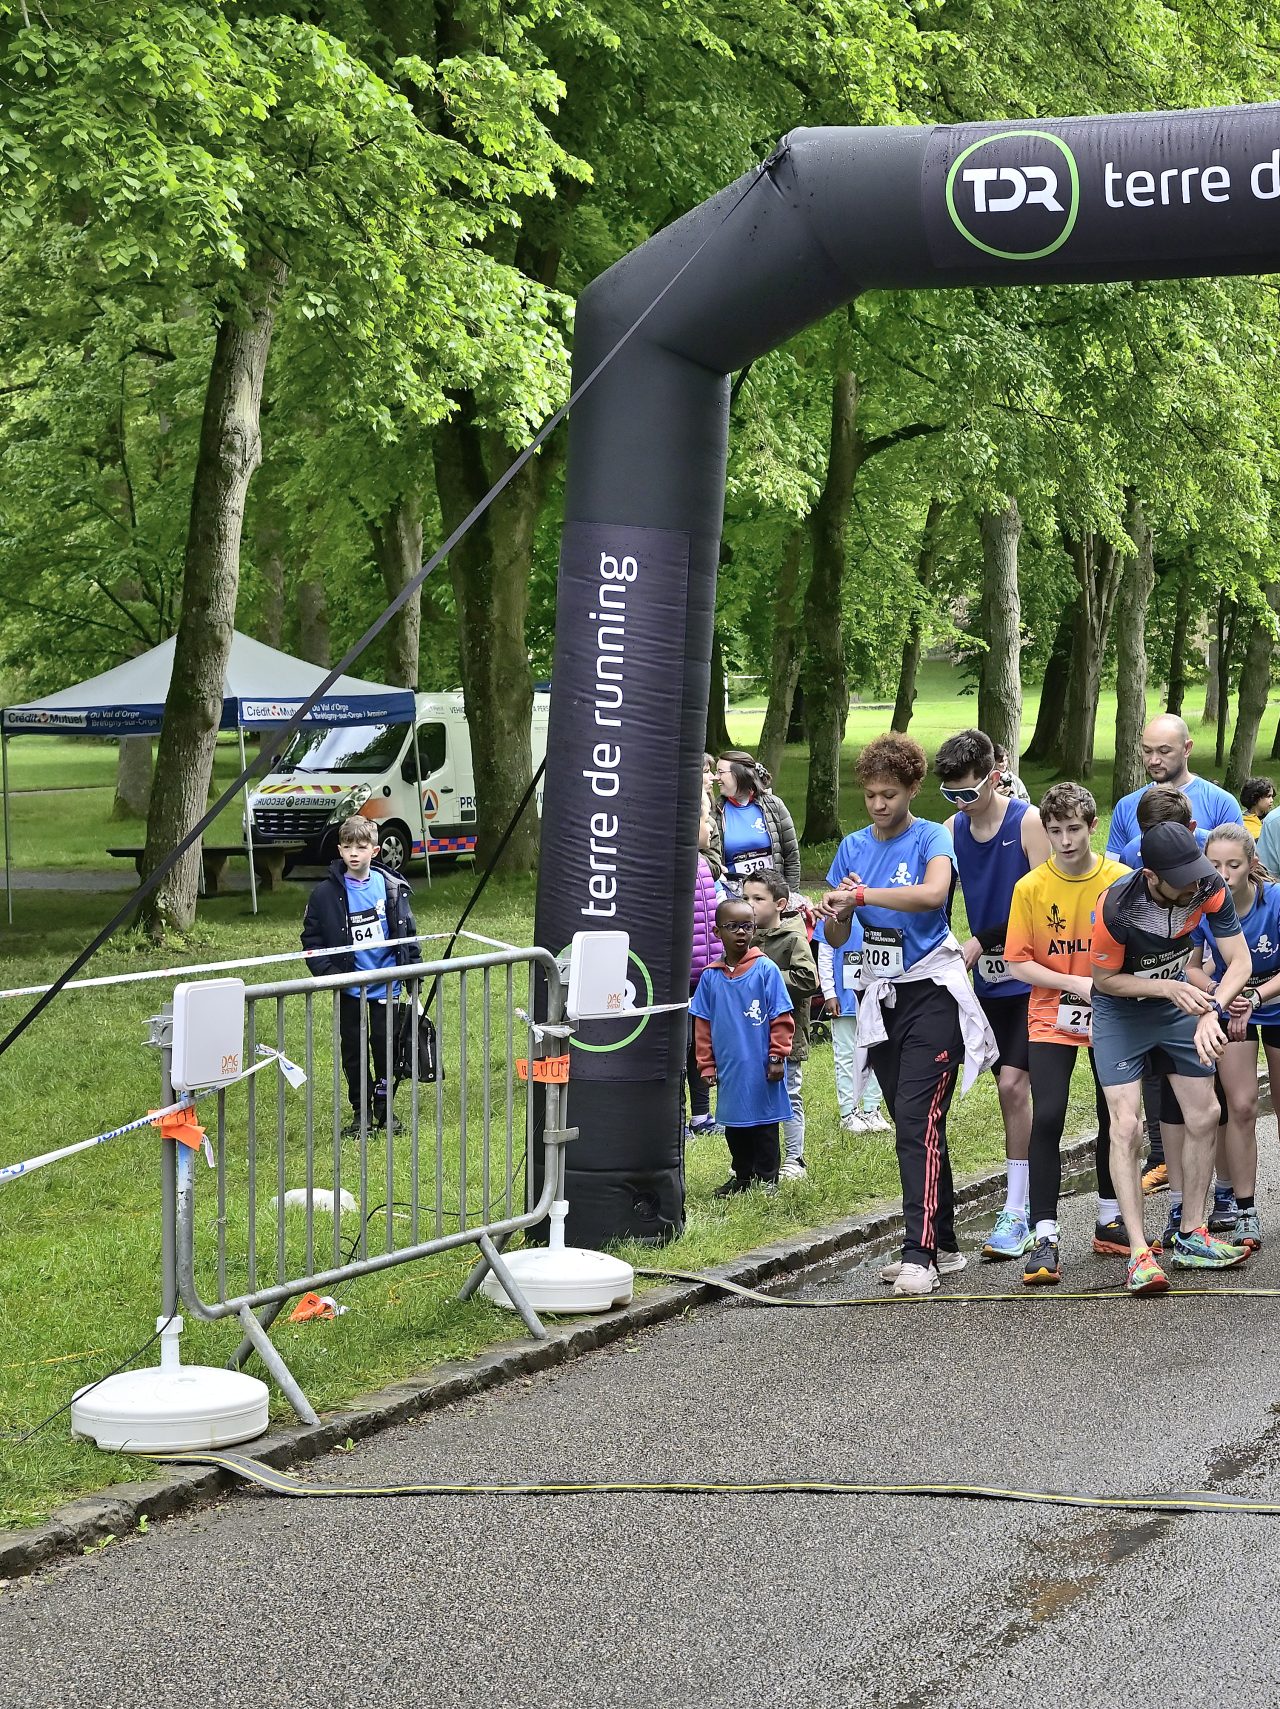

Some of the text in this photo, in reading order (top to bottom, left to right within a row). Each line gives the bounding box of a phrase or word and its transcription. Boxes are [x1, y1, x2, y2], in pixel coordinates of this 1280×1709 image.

[962, 165, 1065, 213] TDR
[1104, 161, 1231, 208] terre
[102, 710, 114, 719] Val
[246, 705, 271, 717] Crédit
[8, 713, 83, 725] Crédit Mutuel
[581, 552, 639, 918] terre de running
[743, 860, 765, 874] 379
[985, 959, 1008, 974] 20
[1142, 958, 1156, 966] TDR
